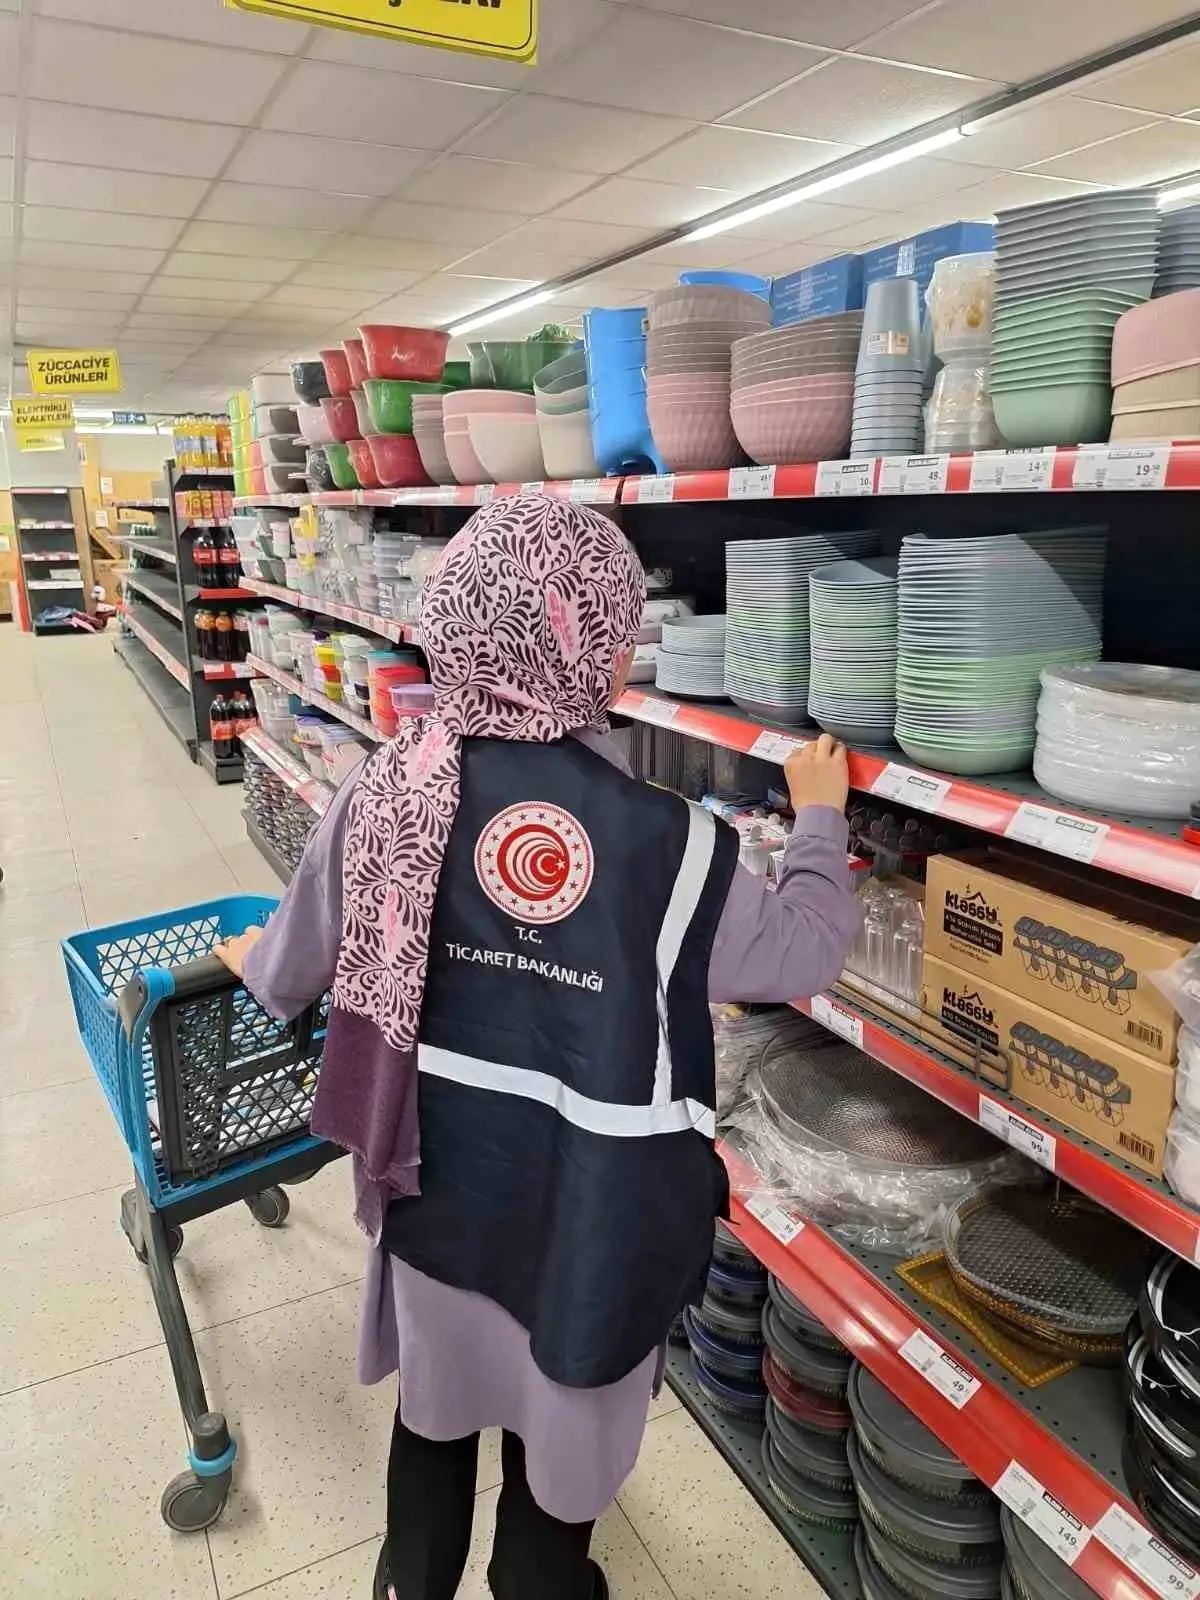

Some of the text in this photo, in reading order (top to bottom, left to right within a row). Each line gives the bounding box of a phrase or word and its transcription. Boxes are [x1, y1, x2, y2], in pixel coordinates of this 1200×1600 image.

[38, 355, 110, 372] ZÜCCACİYE
[45, 369, 108, 385] ÜRÜNLERİ
[16, 416, 28, 424] EV
[1136, 464, 1150, 475] 19
[514, 926, 542, 944] T.C.
[446, 943, 604, 993] TİCARET BAKANLIĞI
[952, 1380, 965, 1391] 49
[1058, 1527, 1077, 1546] 149
[1168, 1574, 1184, 1590] 99
